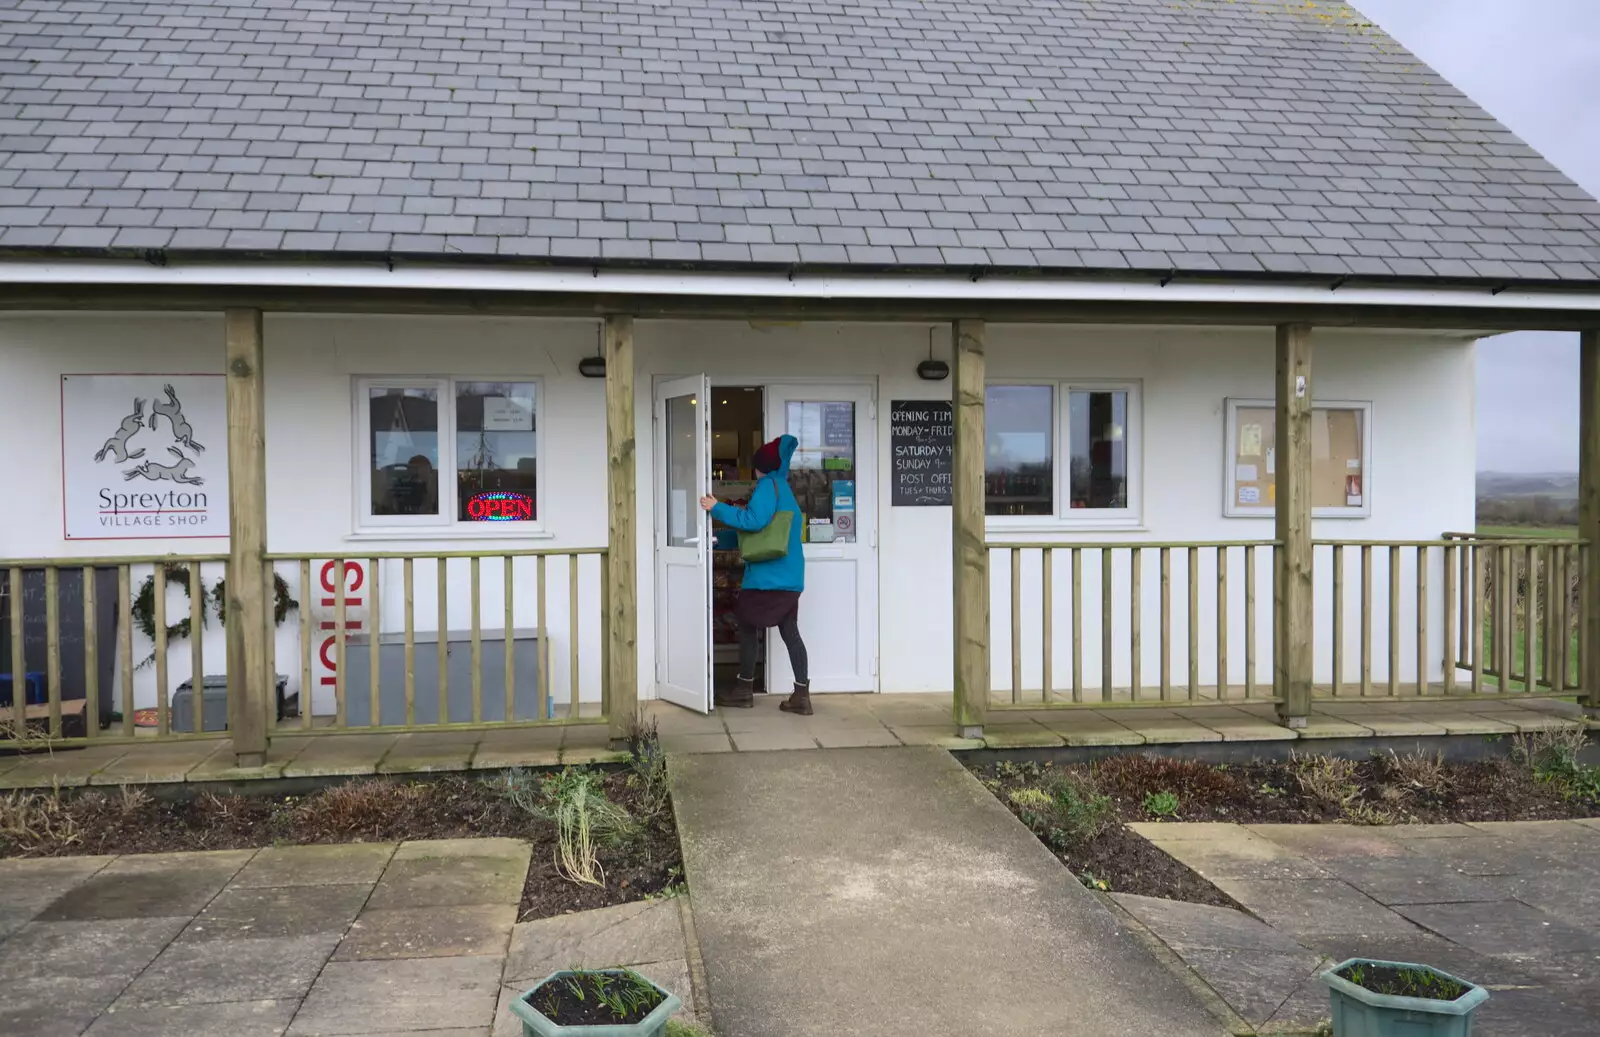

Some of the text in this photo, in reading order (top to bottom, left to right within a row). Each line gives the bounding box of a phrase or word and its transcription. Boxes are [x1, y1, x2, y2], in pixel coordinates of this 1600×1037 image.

[892, 412, 929, 421] OPENING
[892, 425, 924, 436] MONDAY
[896, 446, 943, 455] SATURDAY
[896, 459, 930, 469] SUNDAY
[901, 474, 923, 483] POST
[99, 487, 207, 515] Spreyton
[468, 499, 532, 516] OPEN
[99, 516, 208, 526] VILLAGE SHOP
